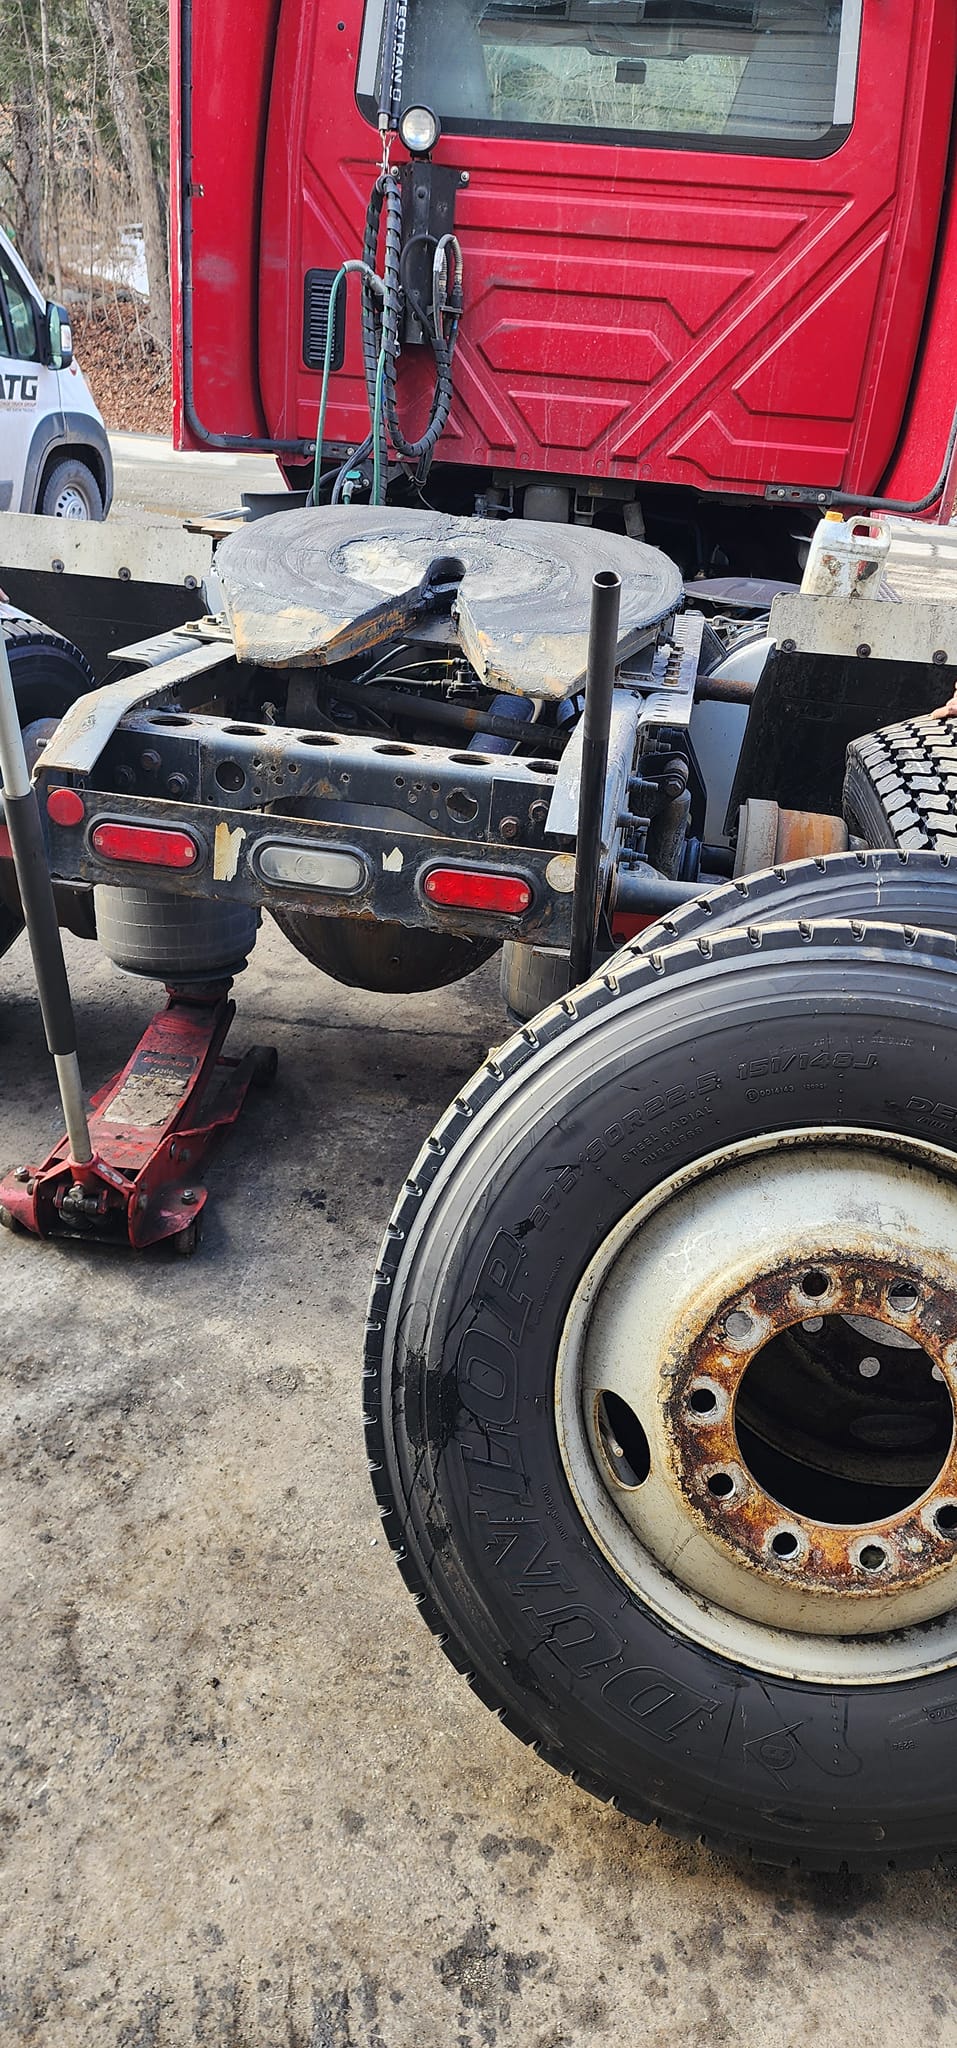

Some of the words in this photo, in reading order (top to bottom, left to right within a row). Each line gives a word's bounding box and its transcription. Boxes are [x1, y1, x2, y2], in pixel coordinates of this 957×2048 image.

[0, 374, 38, 400] TG
[661, 1105, 712, 1135] RADIAL
[457, 1229, 718, 1742] DUNLOP
